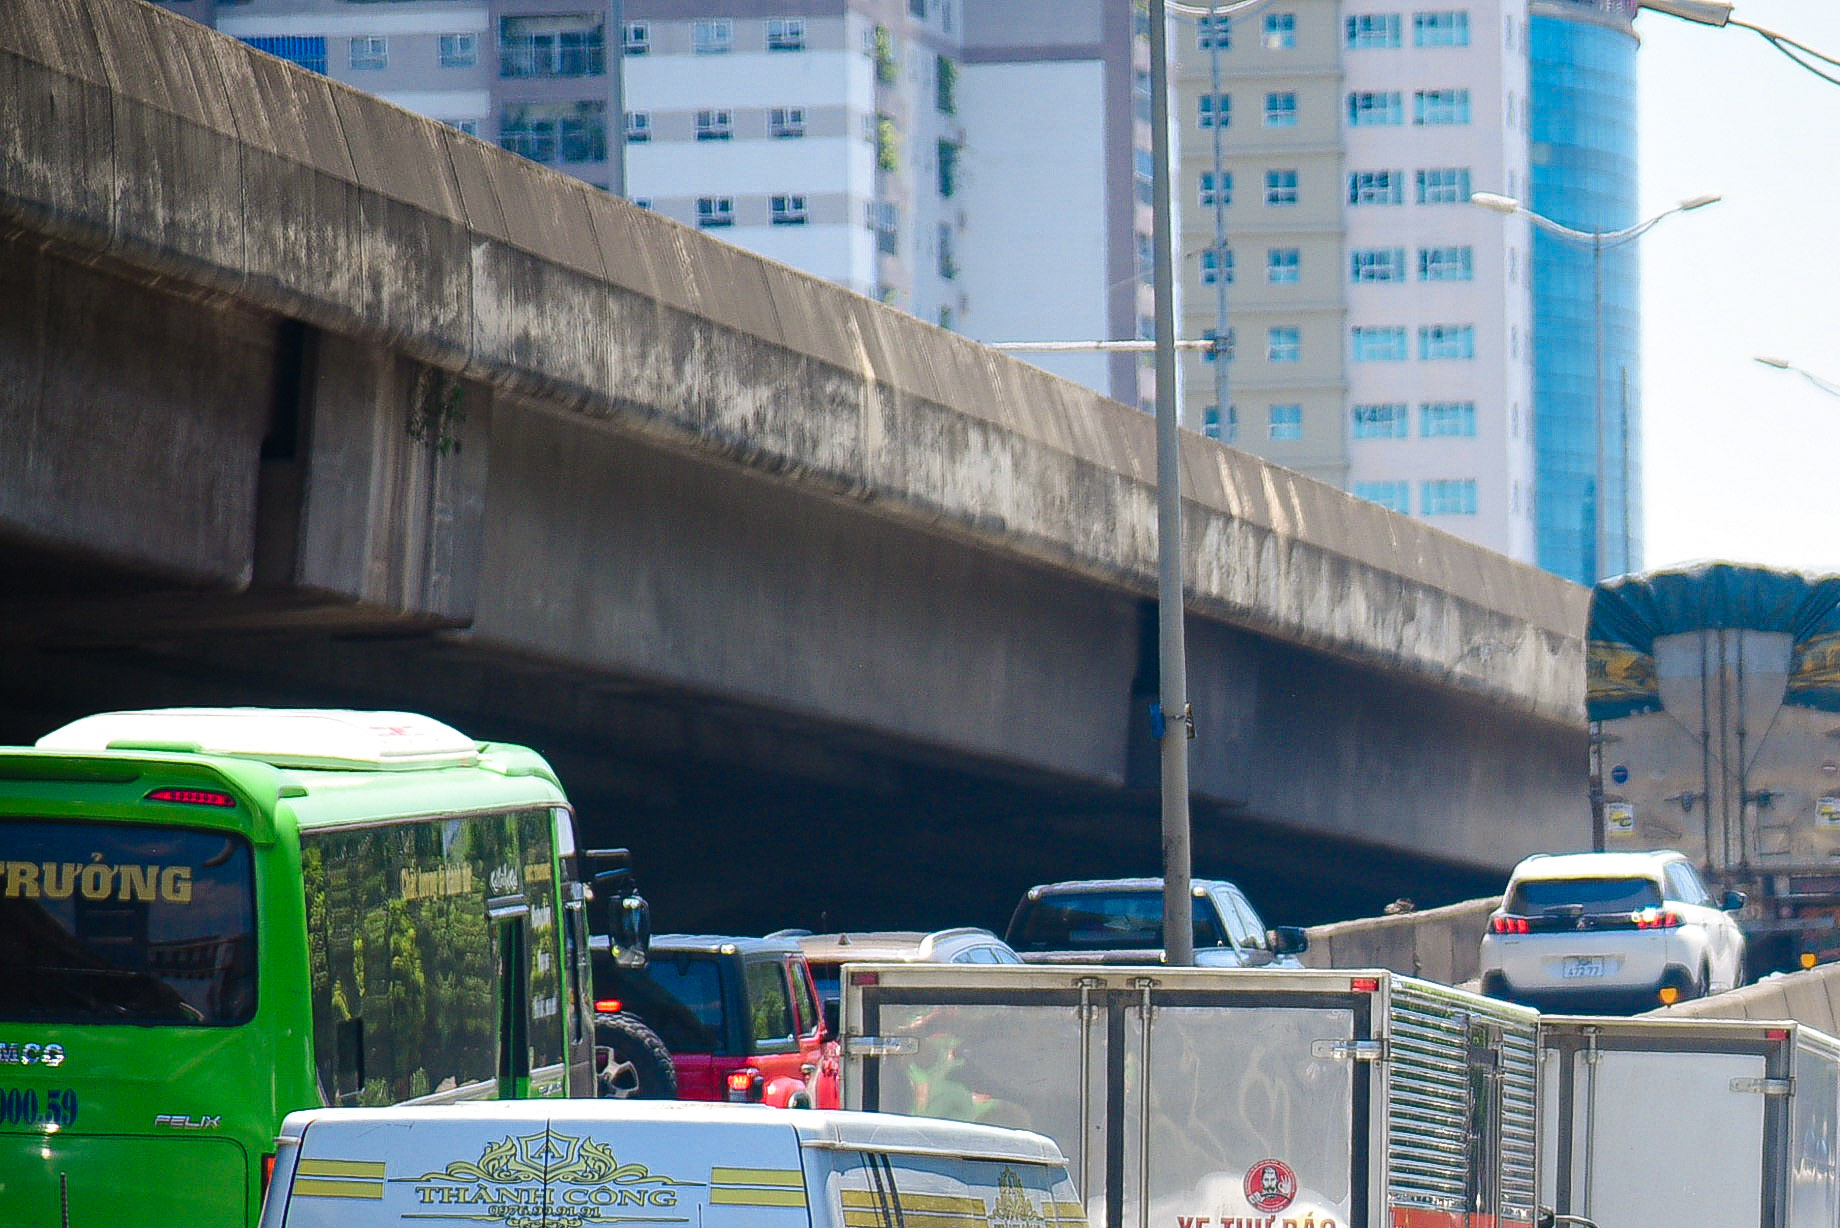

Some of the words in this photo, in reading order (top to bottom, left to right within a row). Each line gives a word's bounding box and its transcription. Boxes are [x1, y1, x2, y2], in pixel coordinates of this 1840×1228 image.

[0, 853, 192, 904] RƯỞNG
[155, 1115, 222, 1128] FELIX
[416, 1180, 555, 1204] THÀNH
[562, 1185, 678, 1207] CÔNG
